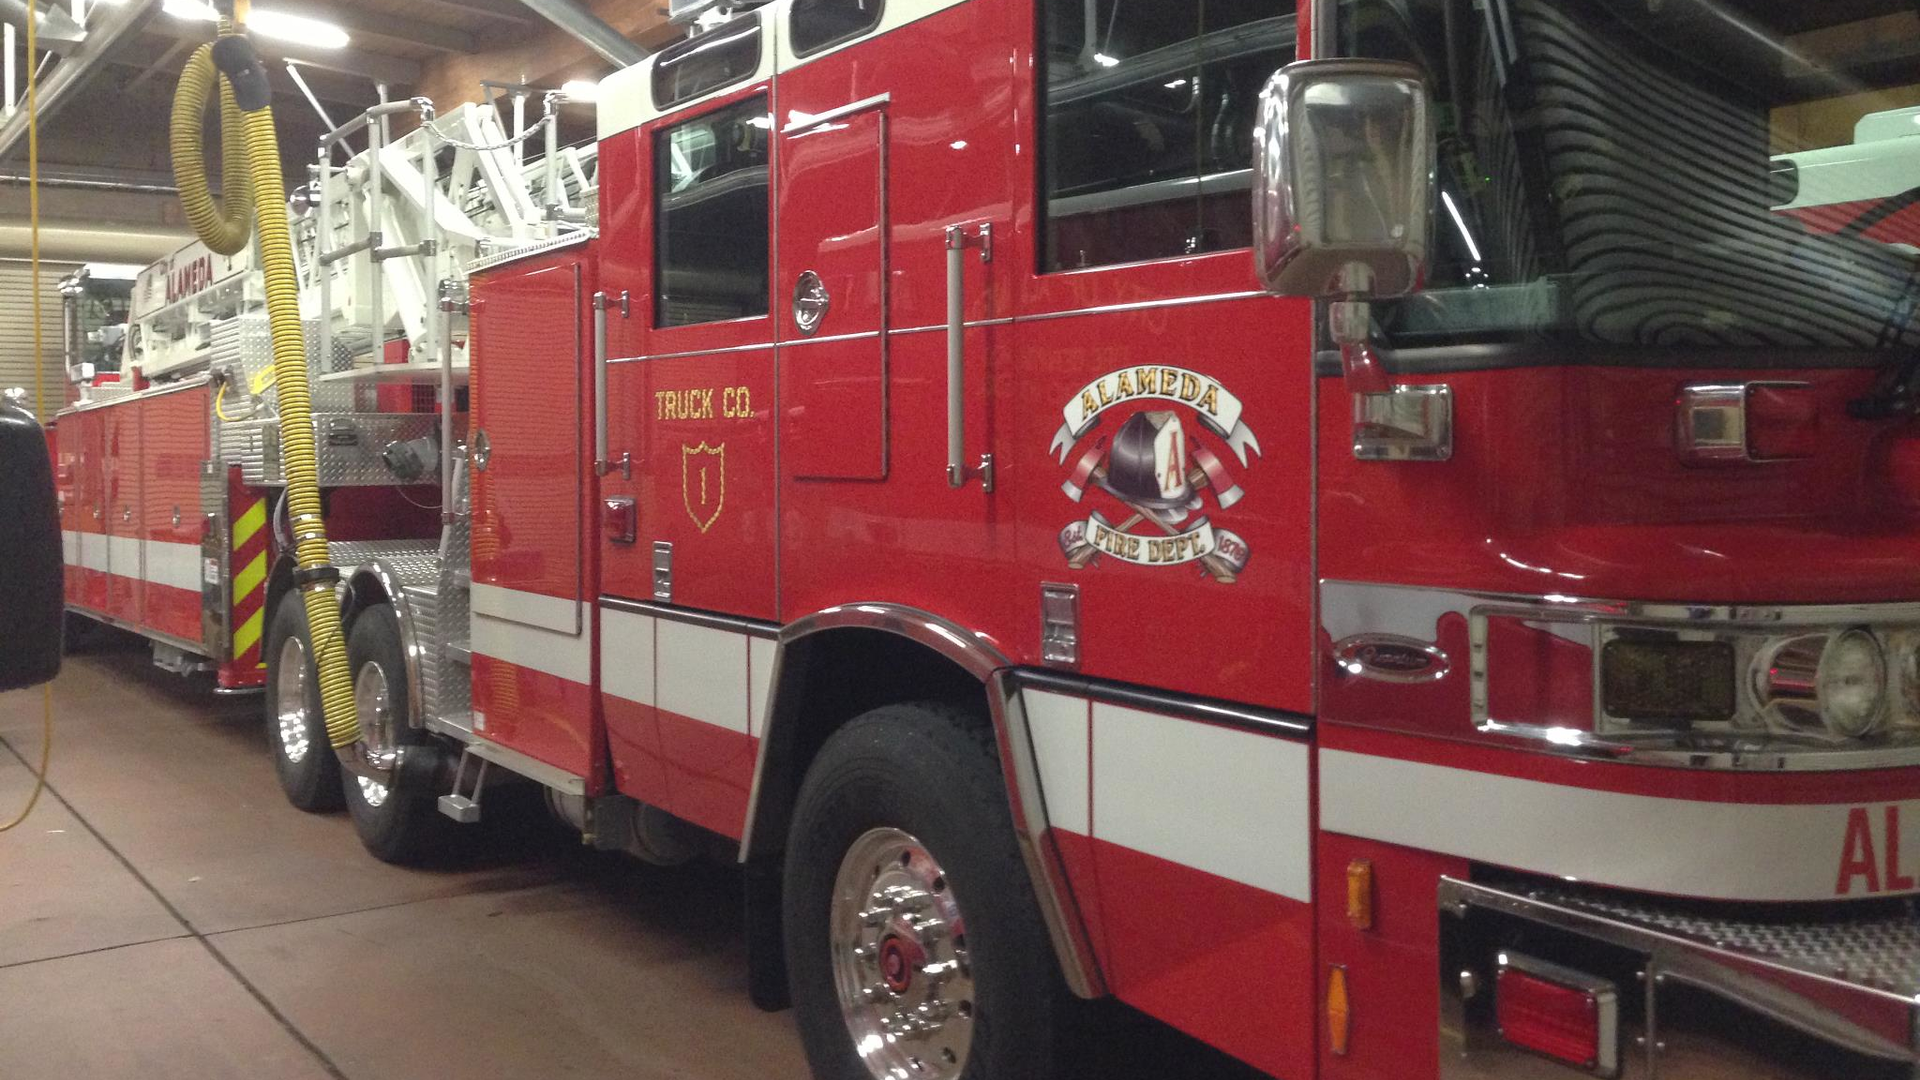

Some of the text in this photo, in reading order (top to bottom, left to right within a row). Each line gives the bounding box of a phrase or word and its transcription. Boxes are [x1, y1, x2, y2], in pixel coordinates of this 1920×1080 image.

[165, 253, 213, 304] ALAMEDA
[655, 386, 755, 420] TRUCK CO.
[1080, 367, 1219, 420] ALAMEDA
[1164, 431, 1183, 492] A
[1094, 525, 1206, 563] FIRE DEPT.
[1835, 805, 1920, 895] AL
